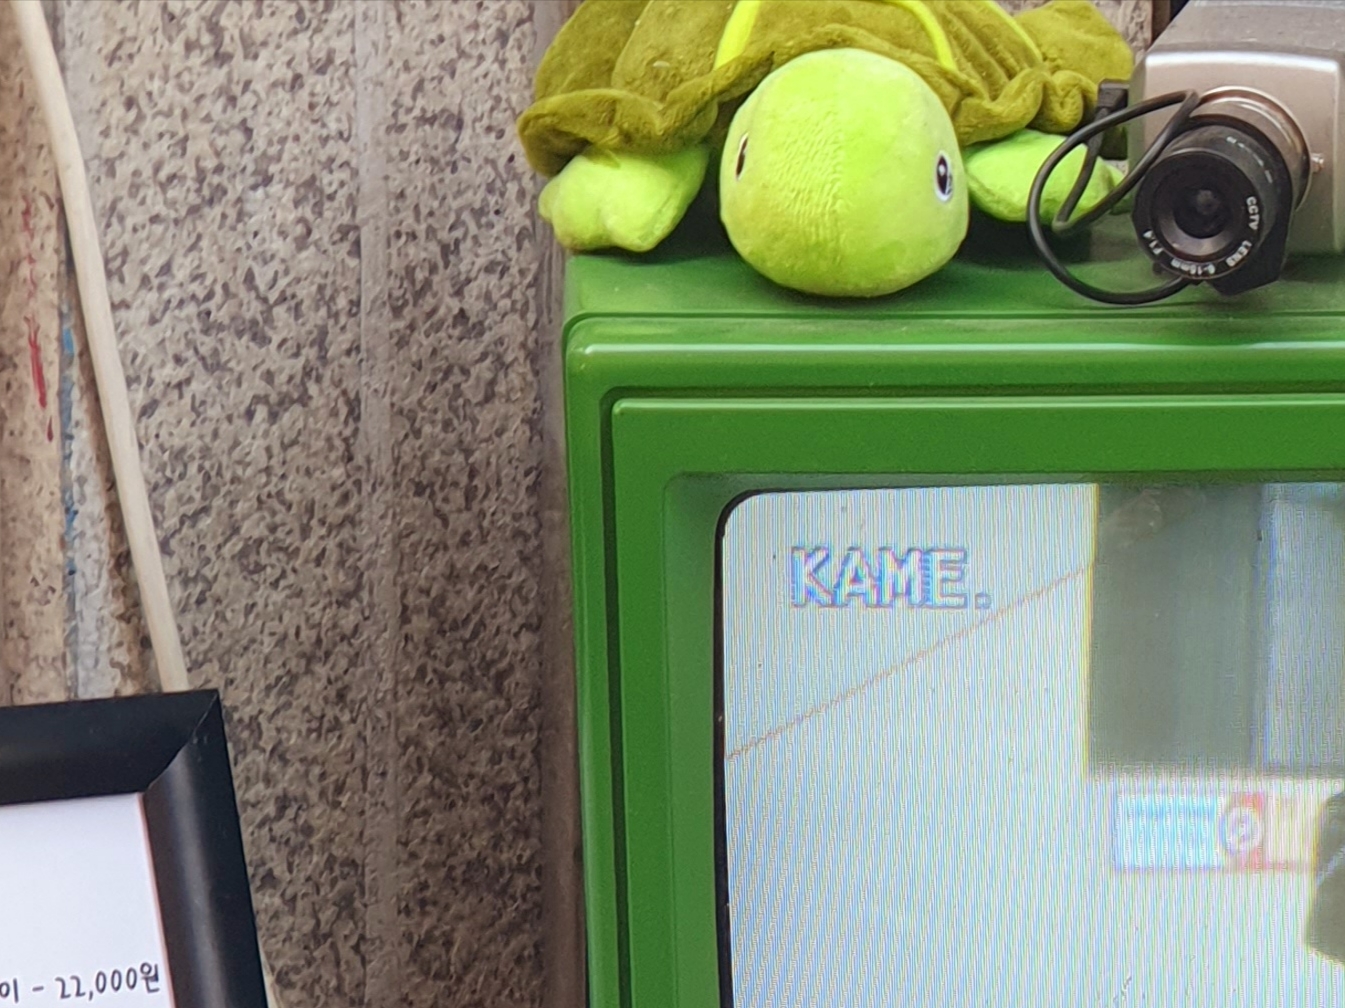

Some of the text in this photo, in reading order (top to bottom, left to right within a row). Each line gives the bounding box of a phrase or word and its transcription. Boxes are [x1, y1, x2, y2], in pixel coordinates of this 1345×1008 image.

[1246, 196, 1260, 231] CCTV
[1225, 240, 1252, 267] LENS
[791, 546, 992, 610] KAME.
[55, 961, 160, 1001] 22,000원
